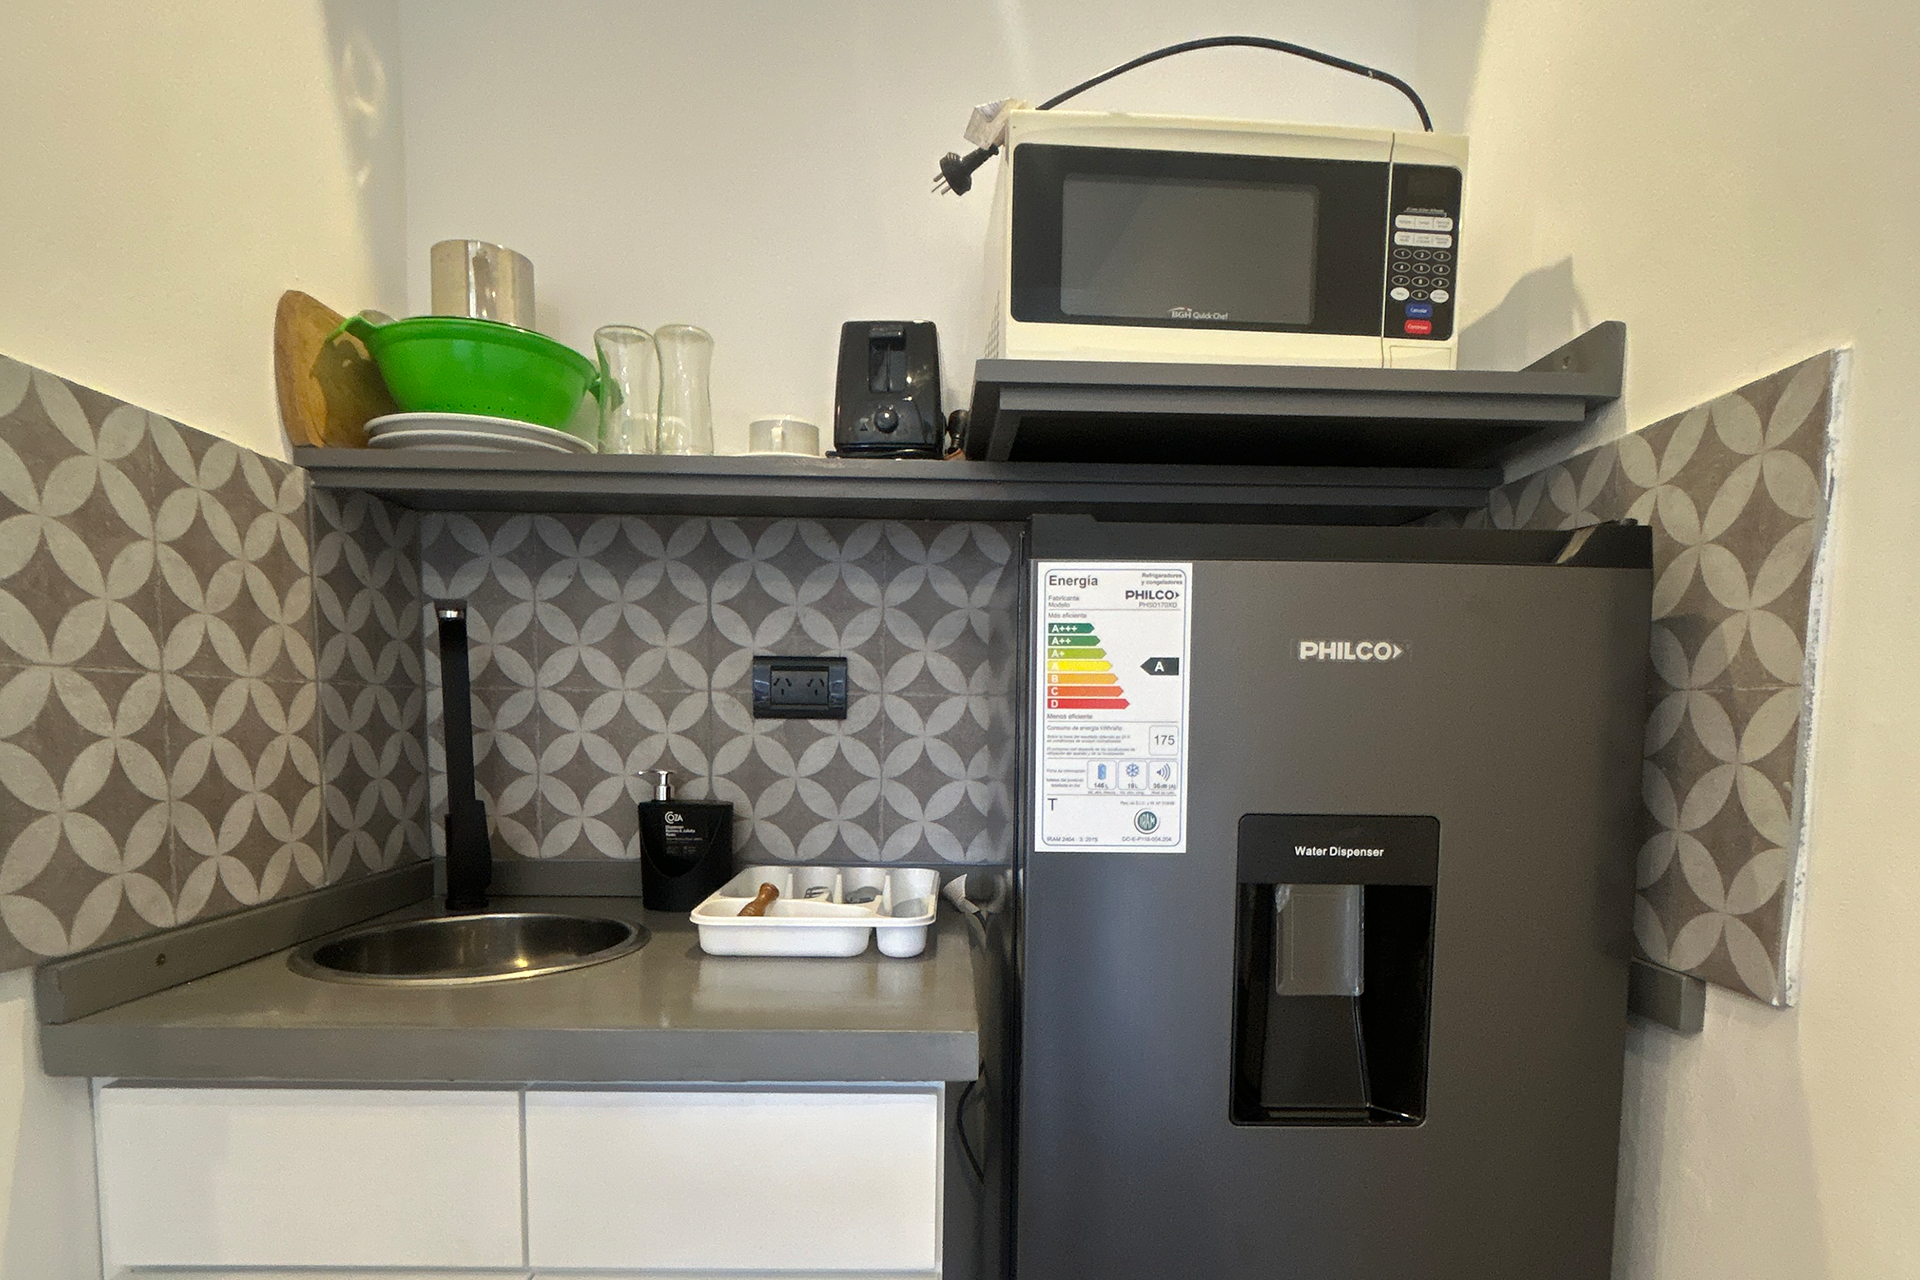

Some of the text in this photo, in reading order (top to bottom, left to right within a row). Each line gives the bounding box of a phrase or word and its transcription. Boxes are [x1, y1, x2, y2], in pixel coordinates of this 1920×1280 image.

[1171, 311, 1192, 319] BGH
[1192, 311, 1212, 320] Quick
[1049, 574, 1098, 588] Energía
[1141, 572, 1182, 580] Refrigeradores
[1125, 590, 1175, 600] PHILCO
[1051, 624, 1078, 633] A+++
[1051, 637, 1071, 646] A++
[1051, 649, 1065, 658] A+
[1299, 641, 1393, 661] PHILCO
[1051, 661, 1059, 671] A
[1154, 661, 1165, 672] A
[1051, 674, 1059, 684] B
[1051, 687, 1059, 696] C
[1051, 699, 1059, 708] D
[1153, 734, 1176, 746] 175
[1047, 797, 1058, 811] T
[664, 810, 684, 825] COZA
[1294, 846, 1385, 859] Water Dispenser
